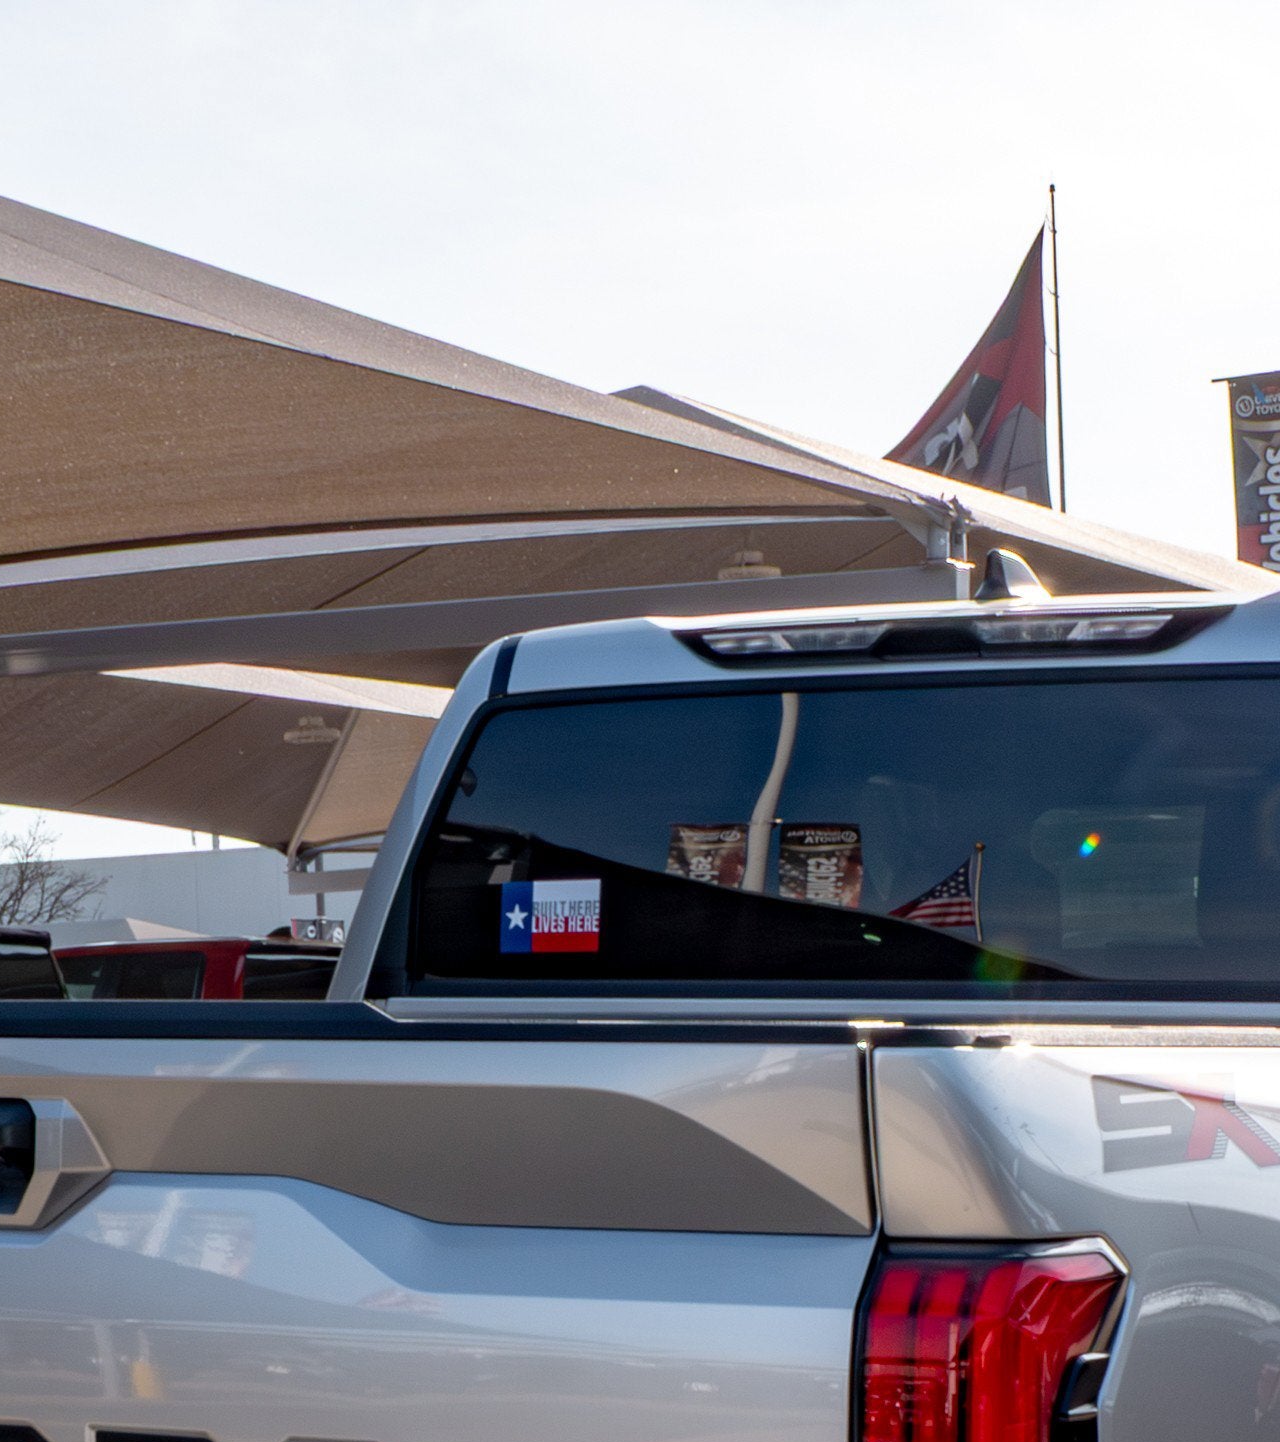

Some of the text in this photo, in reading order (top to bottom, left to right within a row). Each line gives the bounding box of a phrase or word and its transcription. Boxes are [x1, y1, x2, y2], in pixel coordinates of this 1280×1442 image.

[532, 900, 600, 917] BUILT HERE
[531, 915, 600, 933] LIVES HERE
